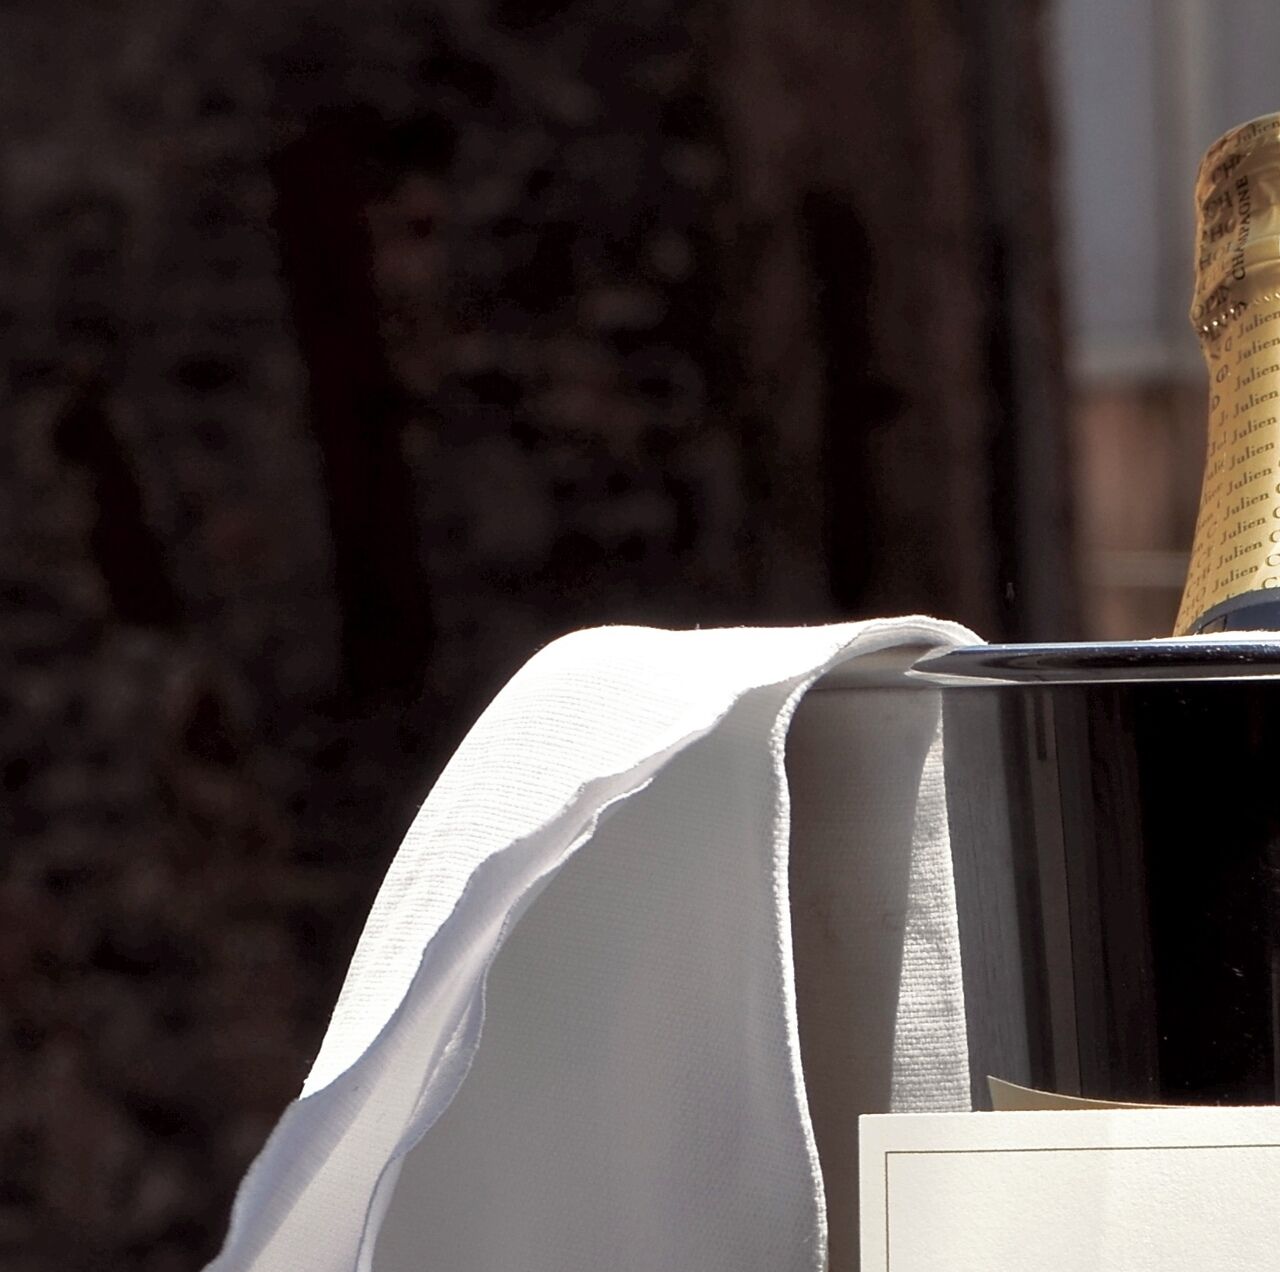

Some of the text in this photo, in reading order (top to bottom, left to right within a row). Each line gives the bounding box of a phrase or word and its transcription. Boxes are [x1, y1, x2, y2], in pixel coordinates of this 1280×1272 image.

[1231, 175, 1250, 281] CHAMPAGNE
[1234, 363, 1280, 393] Julien
[1233, 389, 1280, 419] Julien
[1231, 415, 1278, 446] Julien
[1229, 441, 1276, 471] Julien
[1227, 467, 1273, 497] Julien
[1223, 490, 1270, 521] Julien
[1220, 515, 1267, 546] Julien
[1216, 539, 1263, 571] Julien
[1211, 563, 1259, 594] Julien
